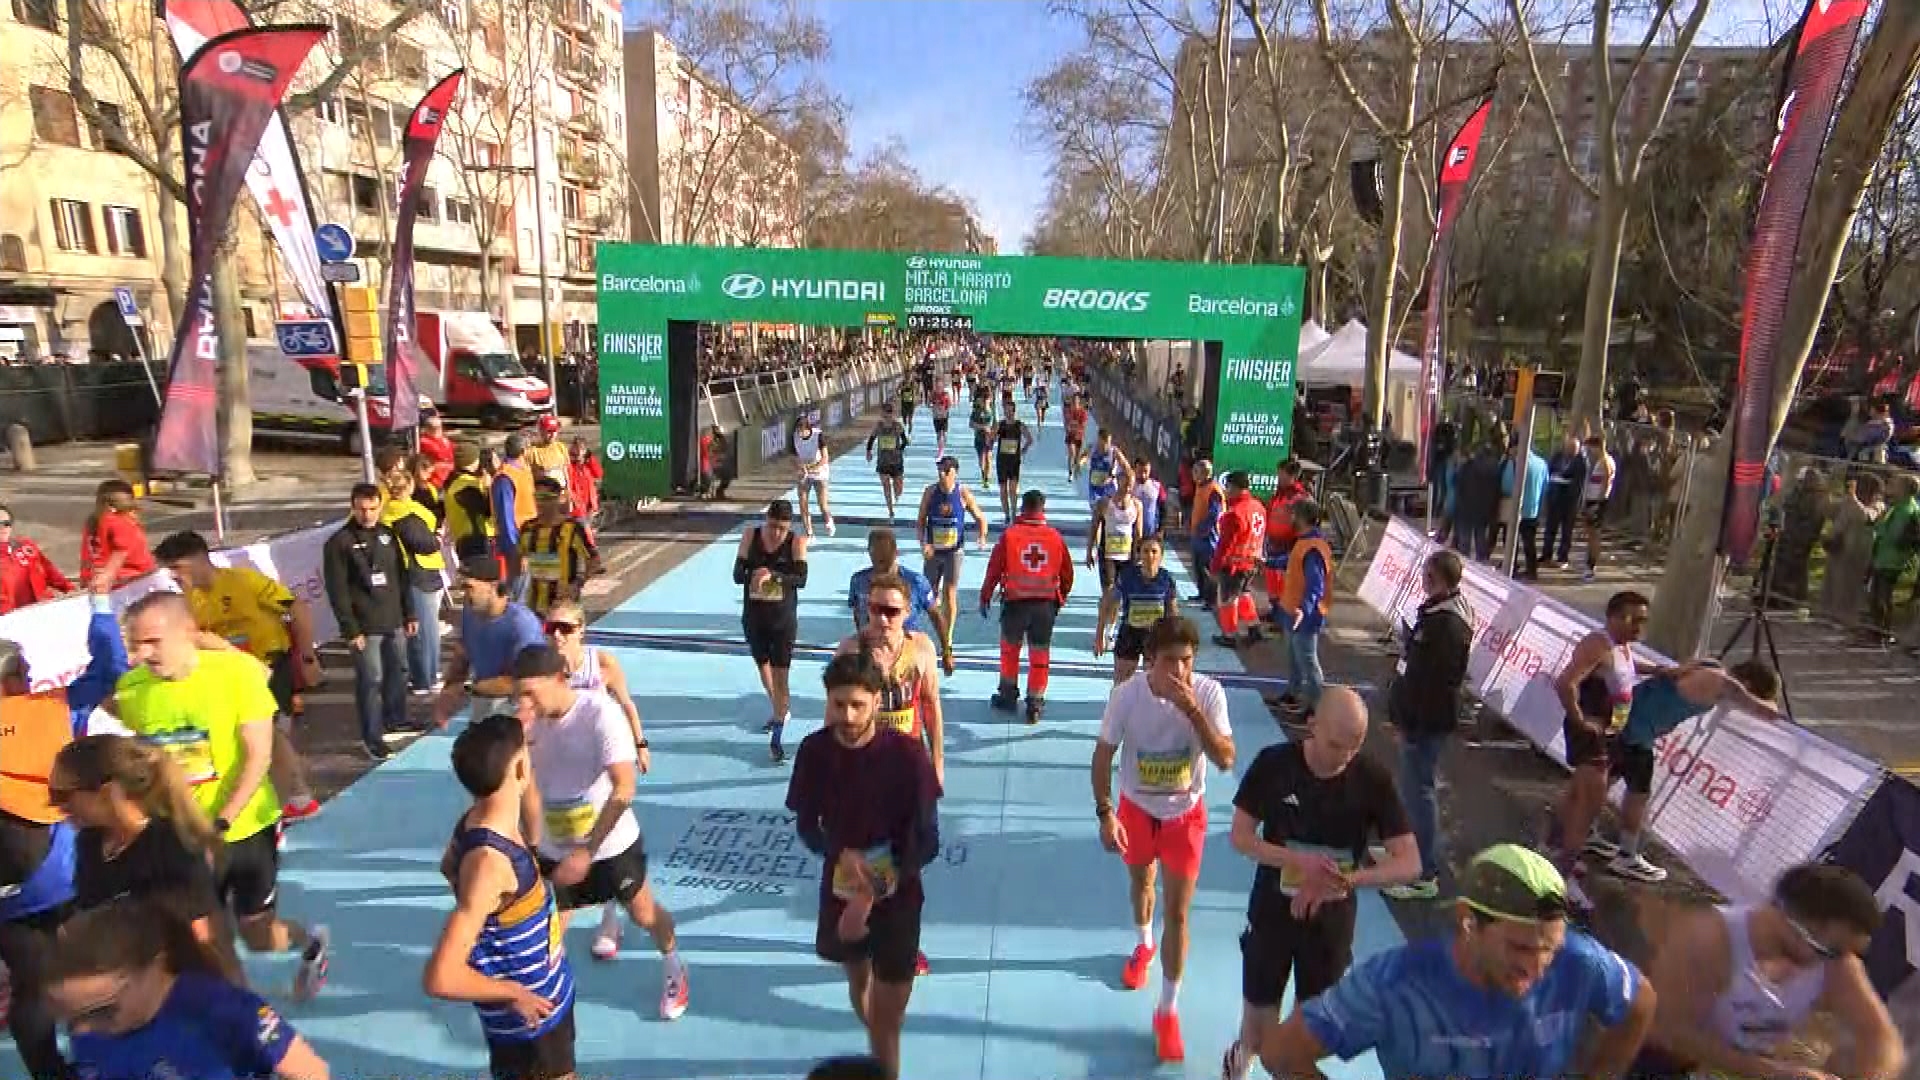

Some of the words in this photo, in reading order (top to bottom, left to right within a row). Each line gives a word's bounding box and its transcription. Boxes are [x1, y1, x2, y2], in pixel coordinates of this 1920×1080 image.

[929, 258, 981, 269] HYUNDAI
[603, 274, 686, 293] Barcelona
[905, 270, 948, 287] MITJA
[772, 281, 885, 302] HYUNDAI
[905, 287, 987, 305] BARCELONA
[1042, 288, 1152, 313] BROOKS
[1188, 294, 1278, 317] Barcelona
[908, 316, 972, 329] 01:25:44
[603, 333, 663, 357] FINISHER
[1226, 359, 1292, 384] FINISHER
[611, 386, 647, 395] SALUD
[649, 386, 656, 395] Y
[605, 406, 663, 417] DEPORTIVA
[1230, 412, 1269, 423] SALUD
[1272, 414, 1279, 424] Y
[1221, 434, 1284, 446] DEPORTIVA
[677, 823, 796, 852] MITJA
[663, 846, 816, 881] BARCEL
[674, 875, 786, 895] BROOKS
